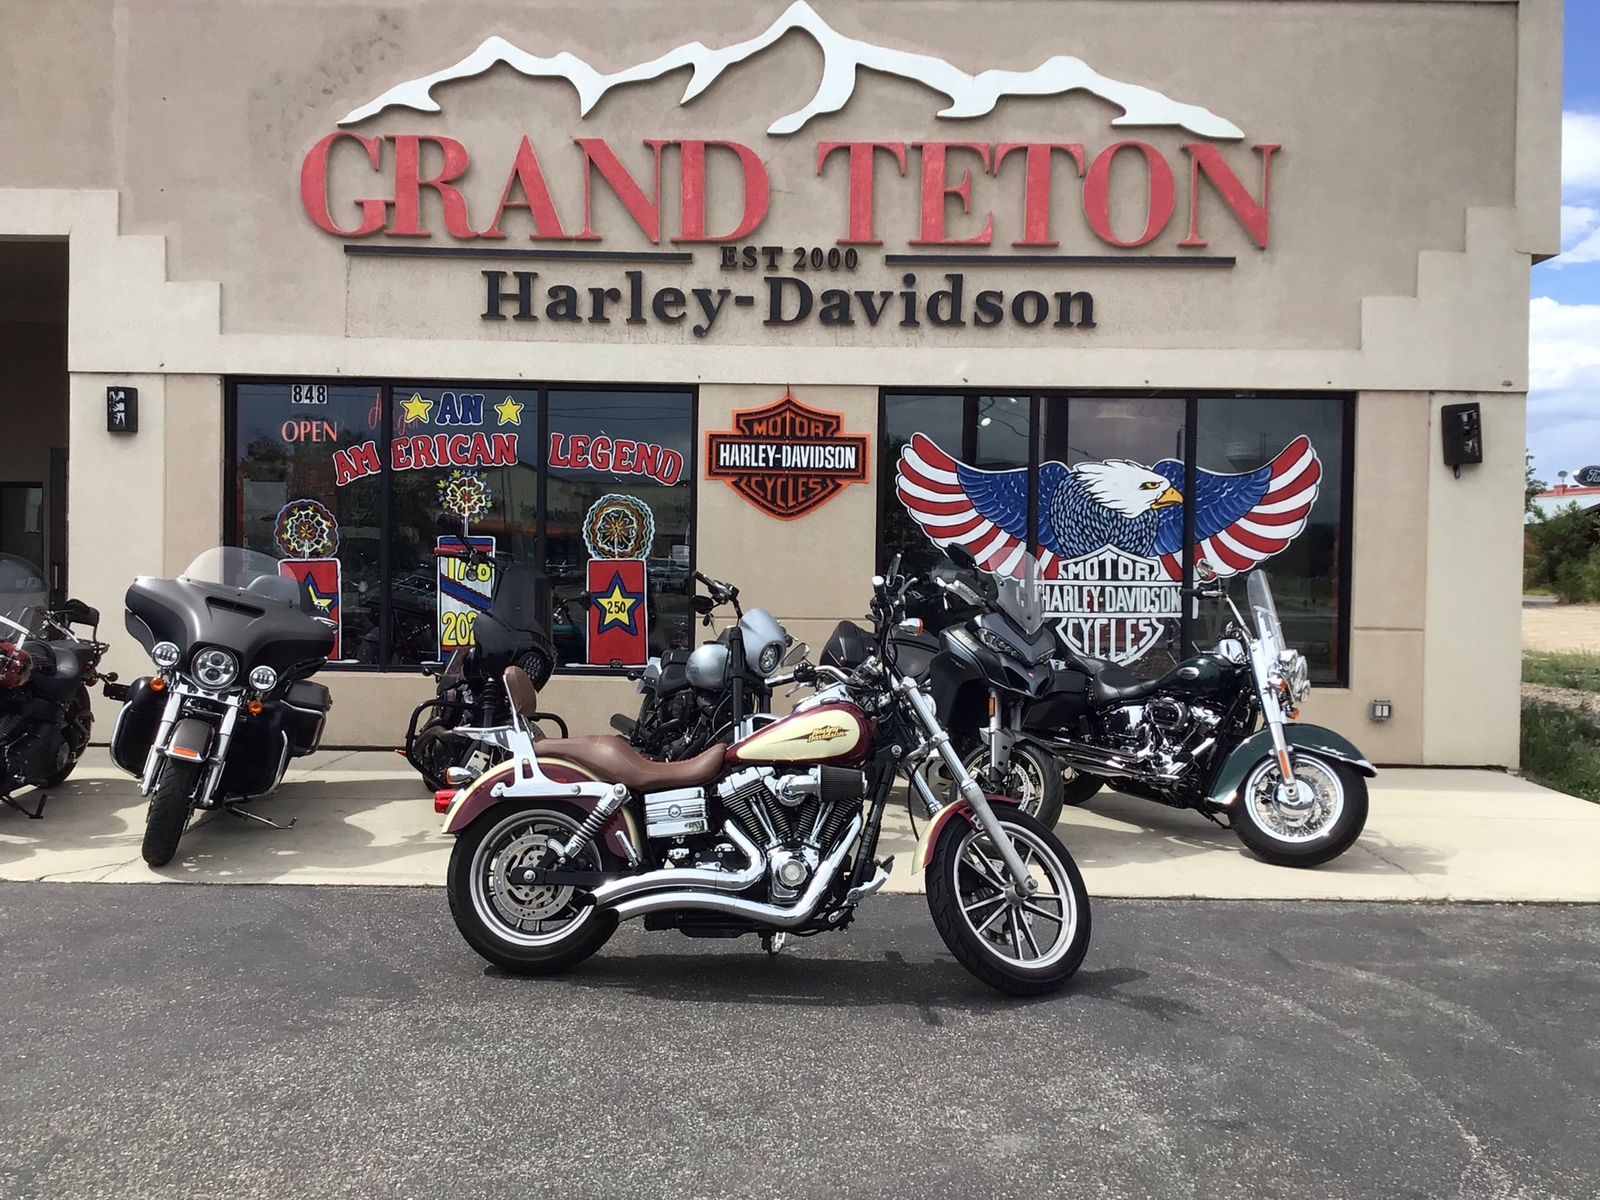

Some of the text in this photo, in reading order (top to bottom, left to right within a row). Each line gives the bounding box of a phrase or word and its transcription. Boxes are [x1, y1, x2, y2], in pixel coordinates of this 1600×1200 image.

[300, 131, 1282, 250] GRAND TETON
[720, 245, 859, 272] EST 2000
[481, 270, 1096, 337] Harley-Davidson
[291, 384, 328, 405] 848
[434, 391, 485, 427] AN
[281, 419, 339, 443] OPEN
[752, 411, 824, 437] MOTOR
[547, 431, 685, 487] LEGEND
[719, 443, 857, 470] HARLEY-DAVIDSON
[750, 476, 823, 508] CYCLES
[1066, 550, 1151, 581] MOTOR
[606, 600, 627, 615] 250
[441, 610, 478, 647] 202
[1067, 617, 1153, 659] CYCLES
